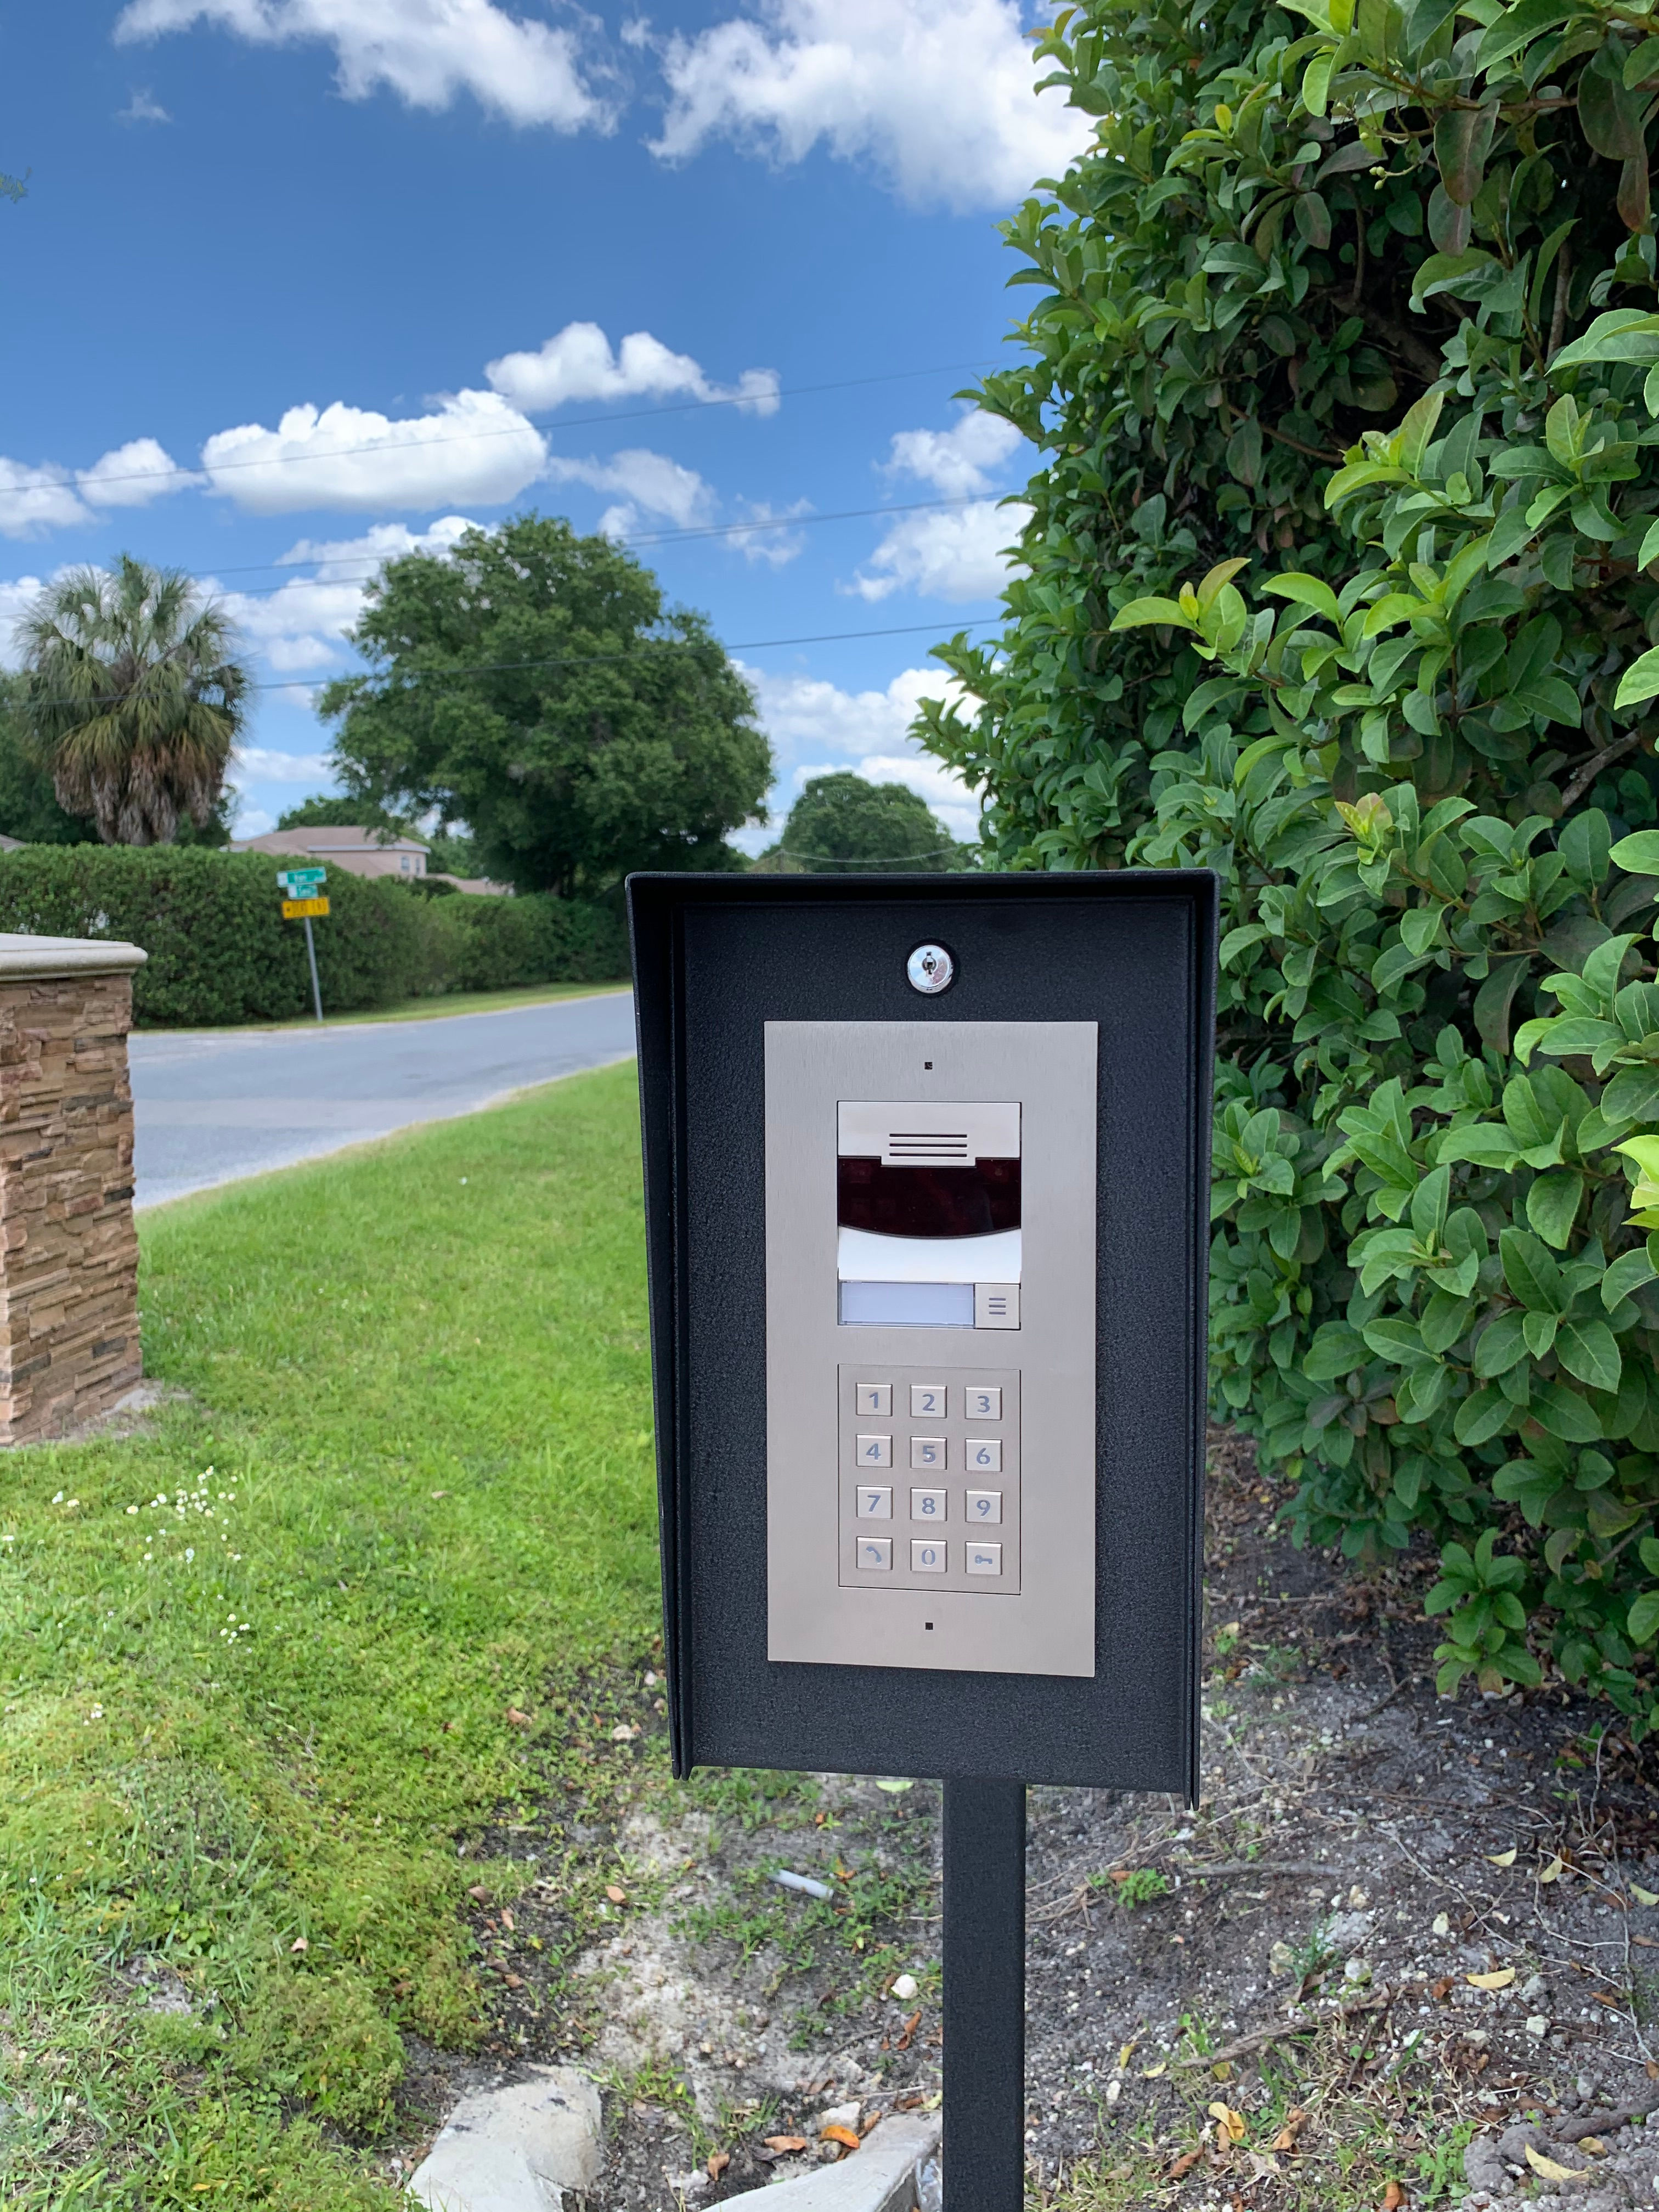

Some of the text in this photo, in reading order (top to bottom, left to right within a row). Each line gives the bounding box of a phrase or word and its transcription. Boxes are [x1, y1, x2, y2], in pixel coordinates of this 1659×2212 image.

[869, 1392, 878, 1408] 1
[922, 1393, 935, 1411] 2
[977, 1395, 990, 1413] 3
[866, 1443, 881, 1460] 4
[922, 1445, 936, 1463] 5
[976, 1448, 990, 1465] 6
[867, 1495, 881, 1513] 7
[922, 1497, 936, 1515] 8
[977, 1499, 991, 1516] 9
[921, 1549, 936, 1566] 0
